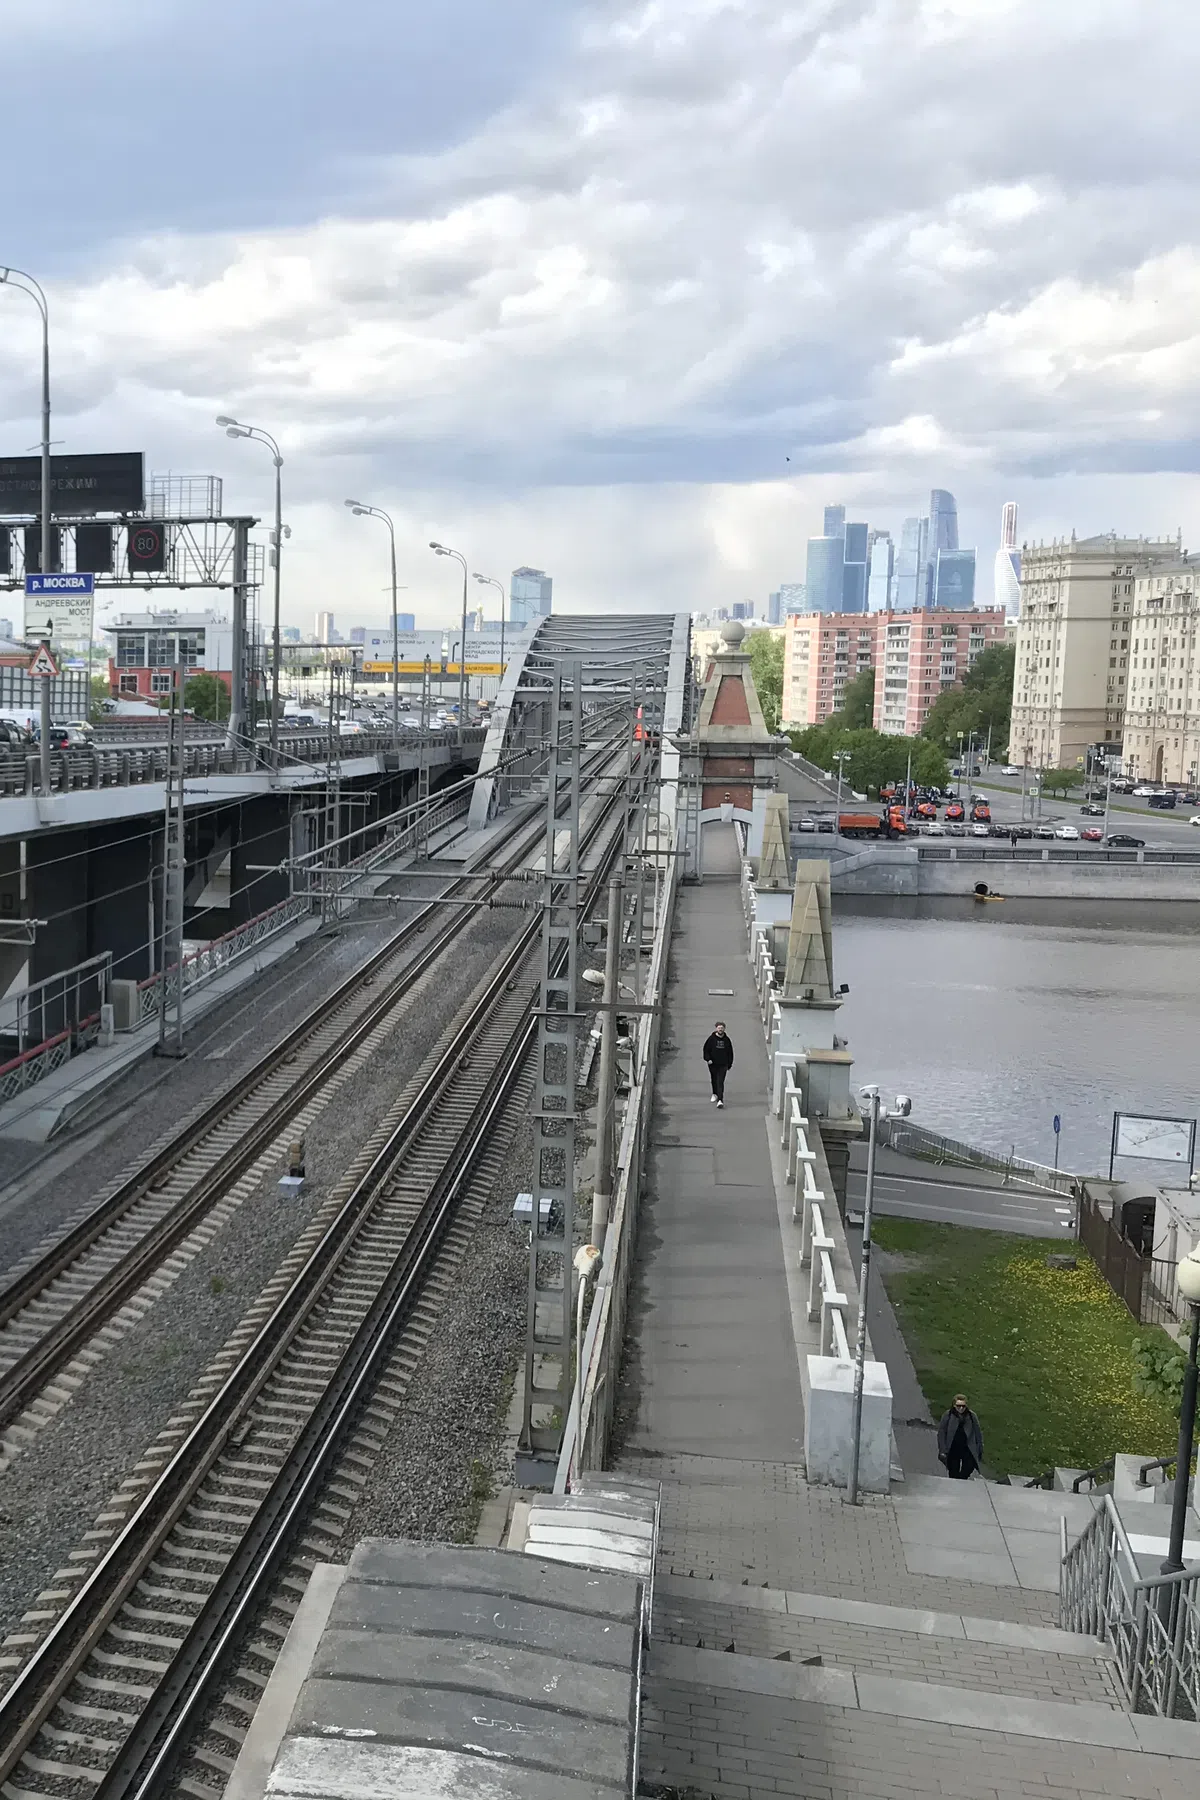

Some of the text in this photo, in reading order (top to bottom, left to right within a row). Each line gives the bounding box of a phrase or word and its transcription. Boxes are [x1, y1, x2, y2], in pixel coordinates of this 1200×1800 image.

[138, 537, 154, 551] 80
[32, 577, 86, 591] р. МОСКВА
[35, 598, 91, 607] АНДРЕЕВСКИЙ
[68, 607, 91, 616] МОСТ
